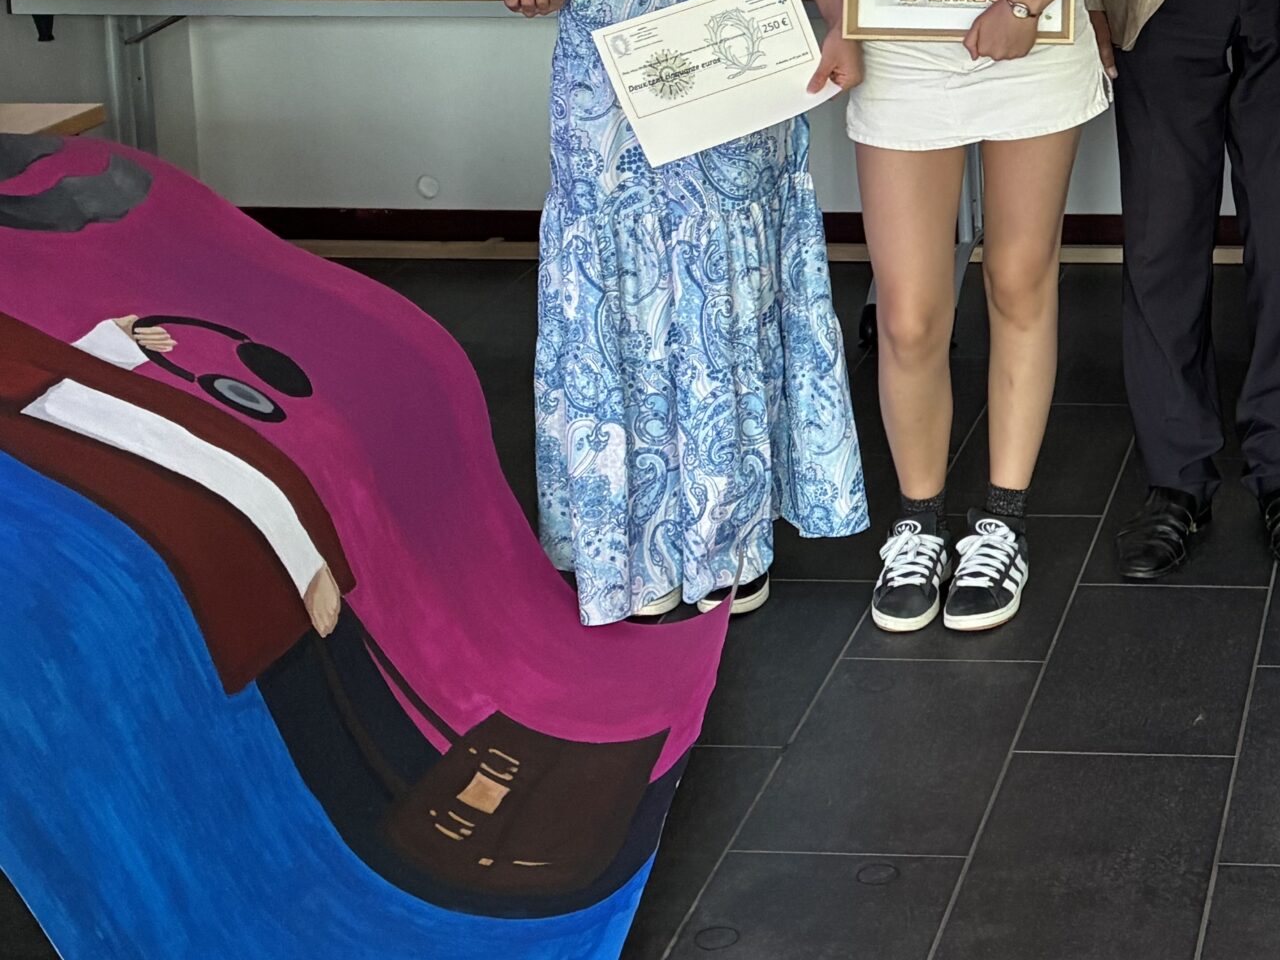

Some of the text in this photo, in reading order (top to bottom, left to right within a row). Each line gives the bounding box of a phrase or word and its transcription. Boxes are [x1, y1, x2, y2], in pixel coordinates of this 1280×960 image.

[762, 18, 789, 33] 250 €
[628, 83, 647, 92] Deux
[701, 58, 721, 68] euros
